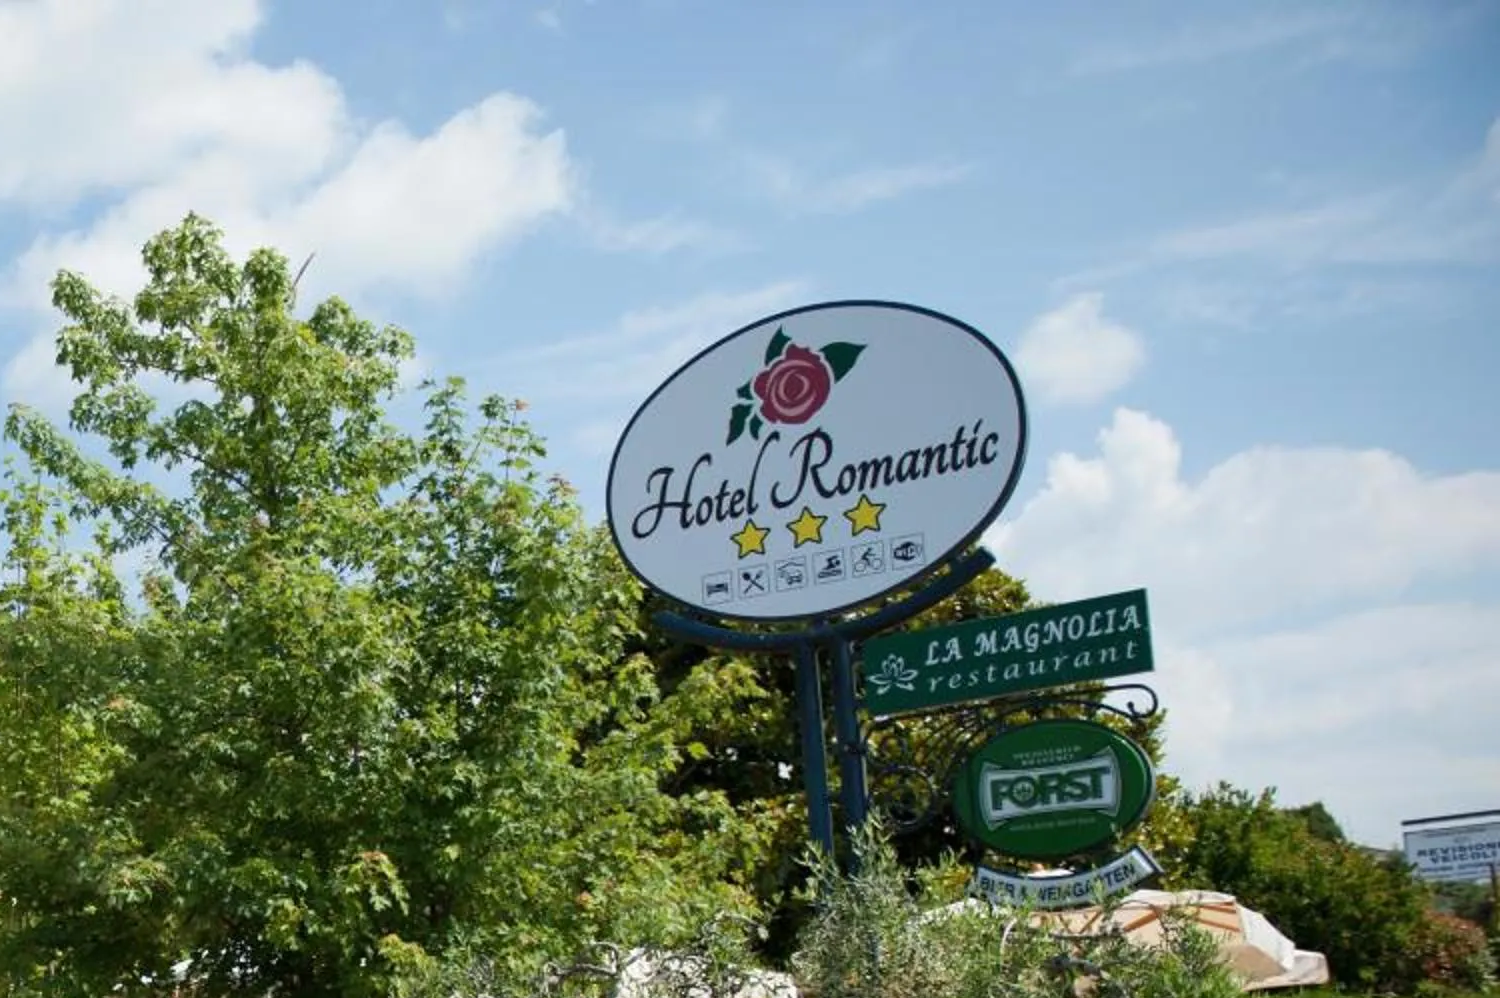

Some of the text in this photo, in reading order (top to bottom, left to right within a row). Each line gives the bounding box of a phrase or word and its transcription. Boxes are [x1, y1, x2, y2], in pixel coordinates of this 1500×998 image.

[632, 418, 999, 539] Hotel Romantic
[925, 605, 1141, 666] LA MAGNOLIA
[929, 640, 1139, 693] restaurant
[990, 766, 1112, 811] FORST
